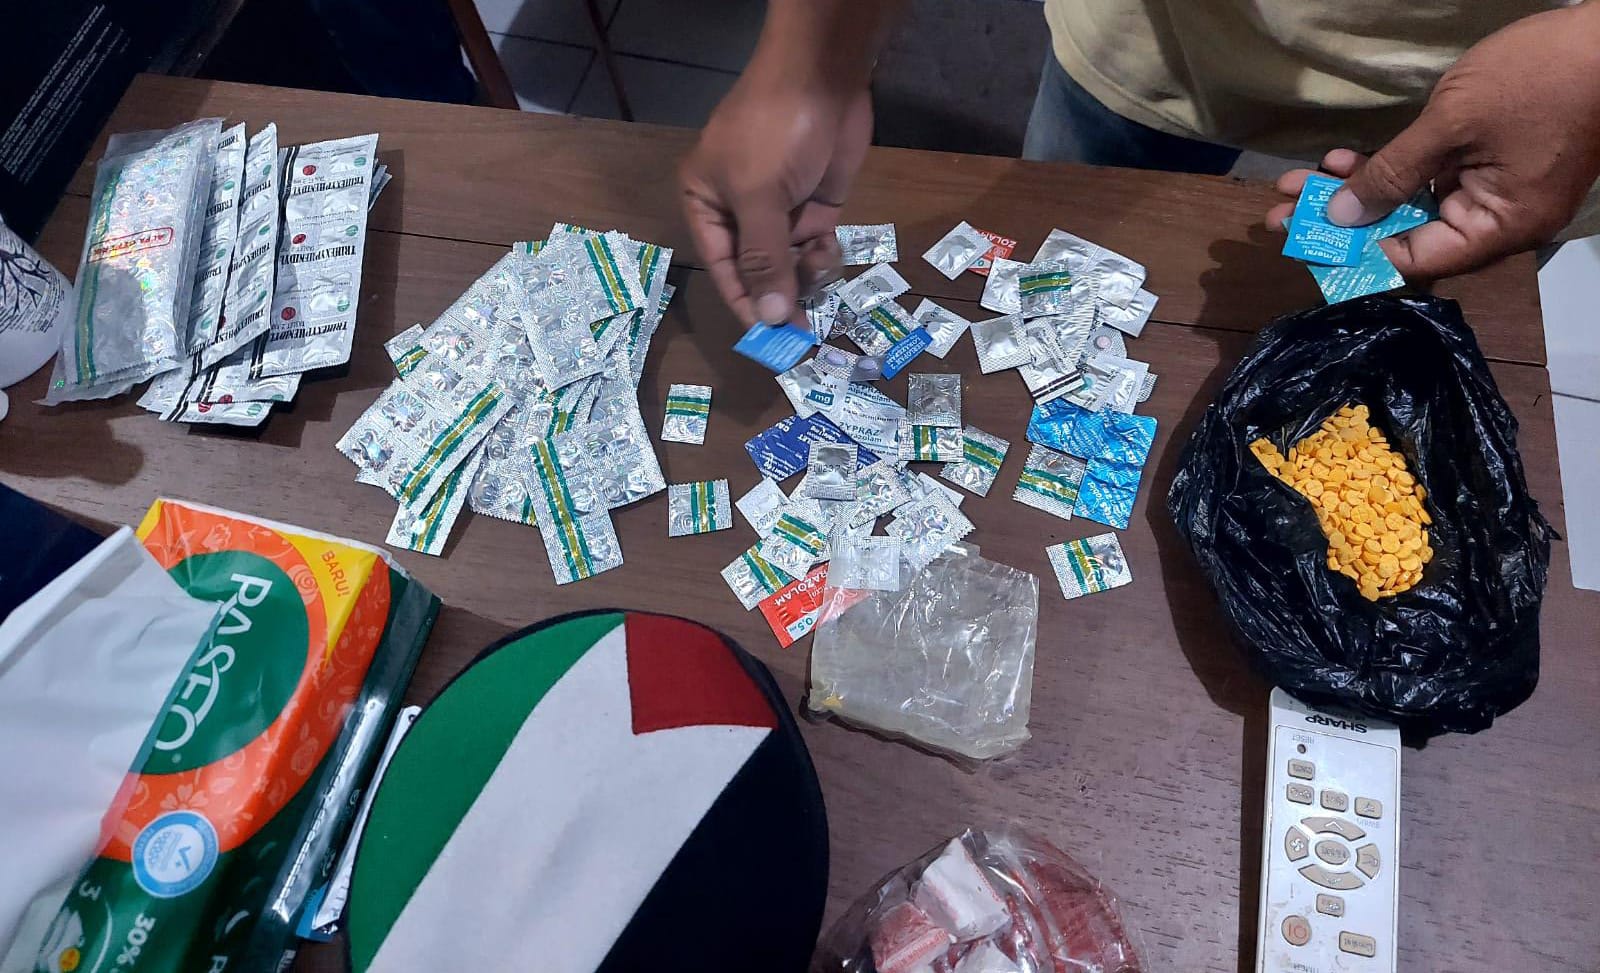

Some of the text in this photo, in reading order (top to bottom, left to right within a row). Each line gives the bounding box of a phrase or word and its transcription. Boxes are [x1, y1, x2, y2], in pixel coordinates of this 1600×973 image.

[840, 421, 881, 436] ZYPRAZ
[321, 551, 350, 597] BARU!
[1305, 715, 1367, 734] SHARP
[117, 912, 156, 965] 30%
